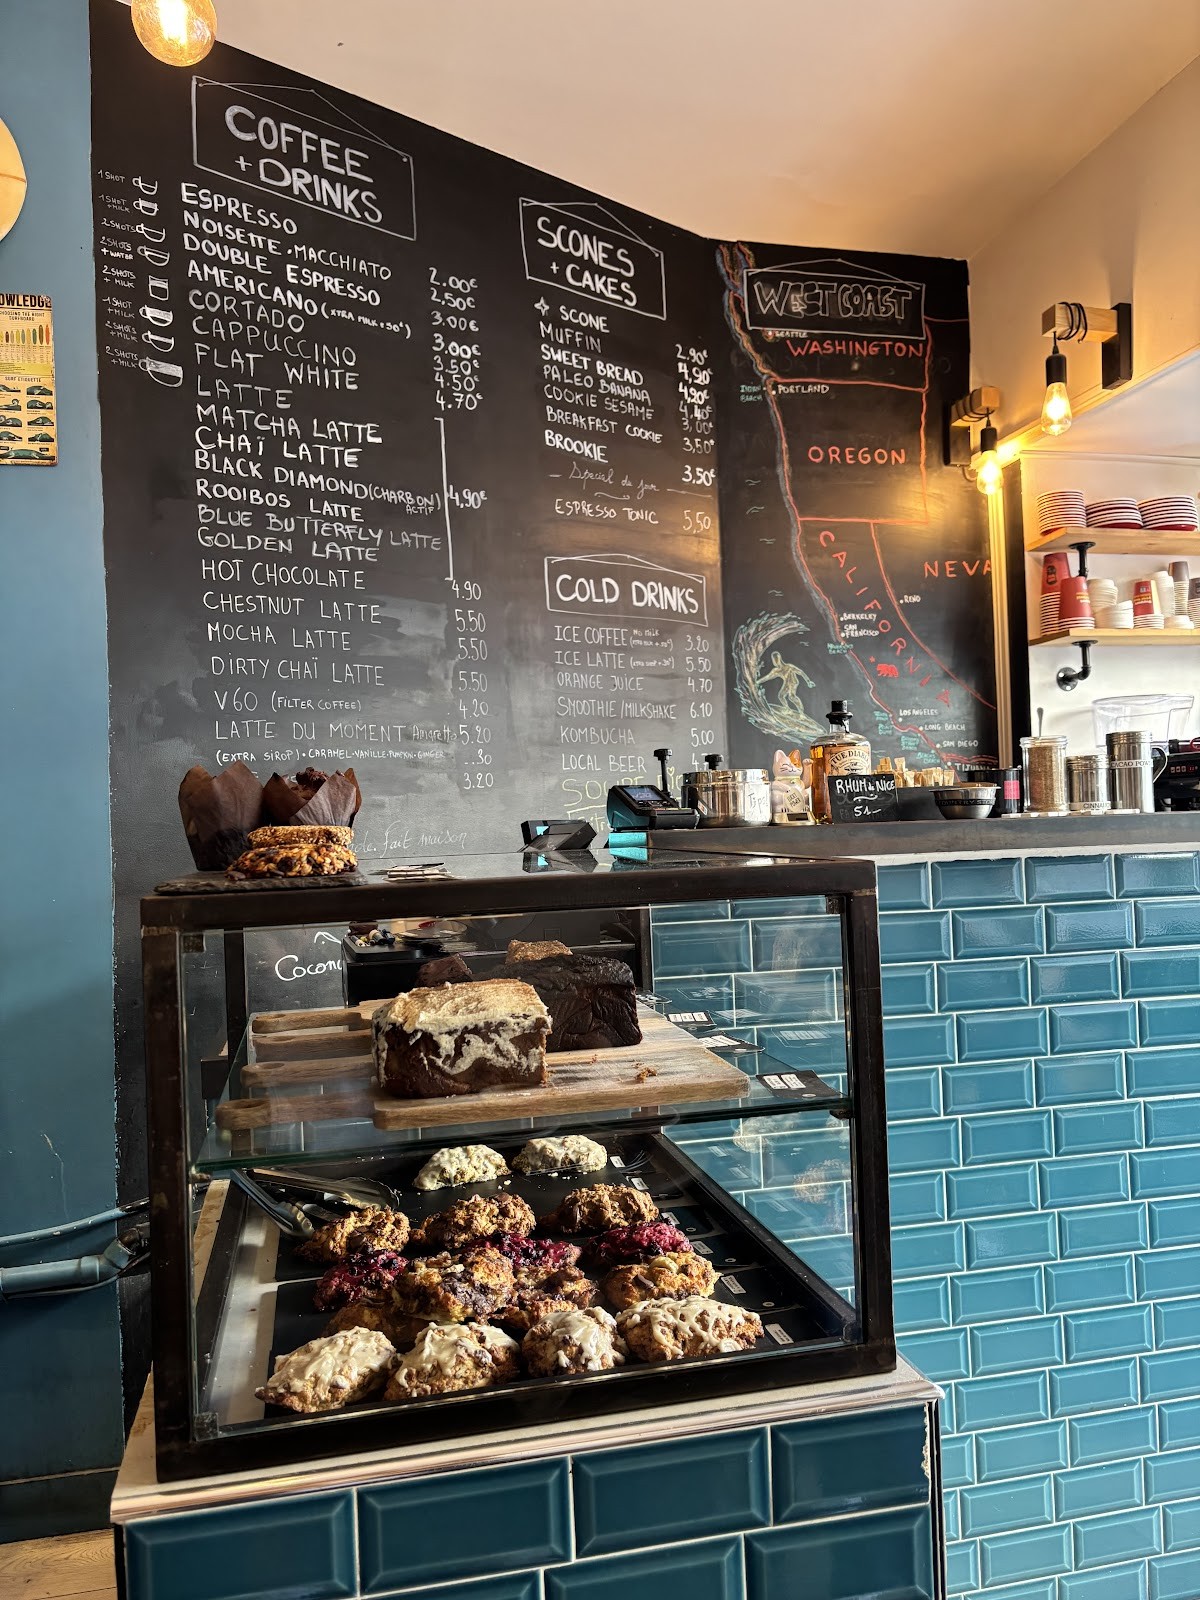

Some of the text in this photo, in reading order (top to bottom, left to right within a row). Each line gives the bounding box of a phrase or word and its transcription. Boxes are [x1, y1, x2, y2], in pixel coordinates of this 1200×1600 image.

[224, 105, 373, 183] COFFEE
[259, 158, 383, 223] DRINKS
[181, 183, 297, 235] ESPRESSO
[183, 211, 281, 255] NOISETTE
[537, 216, 635, 278] SCONES
[183, 233, 381, 306] DOUBLE ESPRESSO
[188, 260, 317, 317] AMERICANO
[565, 263, 637, 307] CAKES
[188, 288, 305, 334] CORTADO
[754, 280, 912, 319] WEST COAST
[559, 306, 610, 333] SCONE
[192, 316, 357, 368] CAPPUCCINO
[539, 321, 602, 353] MUFFIN
[786, 339, 923, 357] WASHINGTON
[194, 342, 360, 391] FLAT WHITE
[541, 344, 644, 386] SWEET BREAD
[197, 374, 294, 409] LATTE
[543, 364, 652, 406] PALEO BANANA
[778, 384, 829, 394] PORTLAND
[543, 384, 654, 421] COOKIE SESAME
[196, 403, 383, 444] MATCHA LATTE
[546, 405, 663, 444] BREAKFAST COOKIE
[283, 440, 363, 468] LATTE
[544, 429, 609, 464] BROOKIE
[808, 445, 906, 465] OREGON
[195, 449, 263, 480] BLACK
[274, 467, 368, 499] DIAMOND
[196, 478, 365, 523] ROOIBOS LATTE
[555, 499, 659, 525] ESPRESSO TONIC
[197, 503, 442, 550] BLUE BUTTERFLY LATTE
[197, 526, 379, 562] GOLDEN LATTE
[201, 559, 366, 590] HOT CHOCOLATE
[451, 579, 482, 601] 4.90
[556, 574, 700, 615] COLD DRINKS
[904, 595, 921, 604] RENO
[202, 591, 382, 624] CHESTNUT LATTE
[454, 609, 486, 633] 5.50
[207, 621, 351, 650] MOCHA LATTE
[457, 637, 488, 661] 5.50
[554, 625, 581, 644] ICE
[584, 627, 628, 647] COFFEE
[332, 662, 385, 687] LATTE
[555, 651, 581, 667] ICE
[586, 651, 625, 670] LATTE
[685, 656, 711, 672] 5.50
[458, 670, 488, 693] 5.50
[556, 671, 644, 692] ORANGE JUICE
[687, 677, 713, 693] 4.70
[458, 698, 490, 720] 4.20
[556, 696, 618, 719] SMOOTHIE
[689, 702, 713, 719] 6.10
[899, 708, 911, 716] LOS
[215, 720, 277, 740] LATTE
[293, 721, 315, 740] DU
[329, 722, 406, 743] MOMENT
[459, 724, 492, 745] 5.20
[560, 725, 636, 745] KOMBUCHA
[690, 727, 715, 748] 5.00
[945, 723, 966, 731] BEACH
[561, 753, 647, 773] LOCAL BEER
[463, 772, 494, 790] 3.20
[836, 778, 868, 794] RHUM
